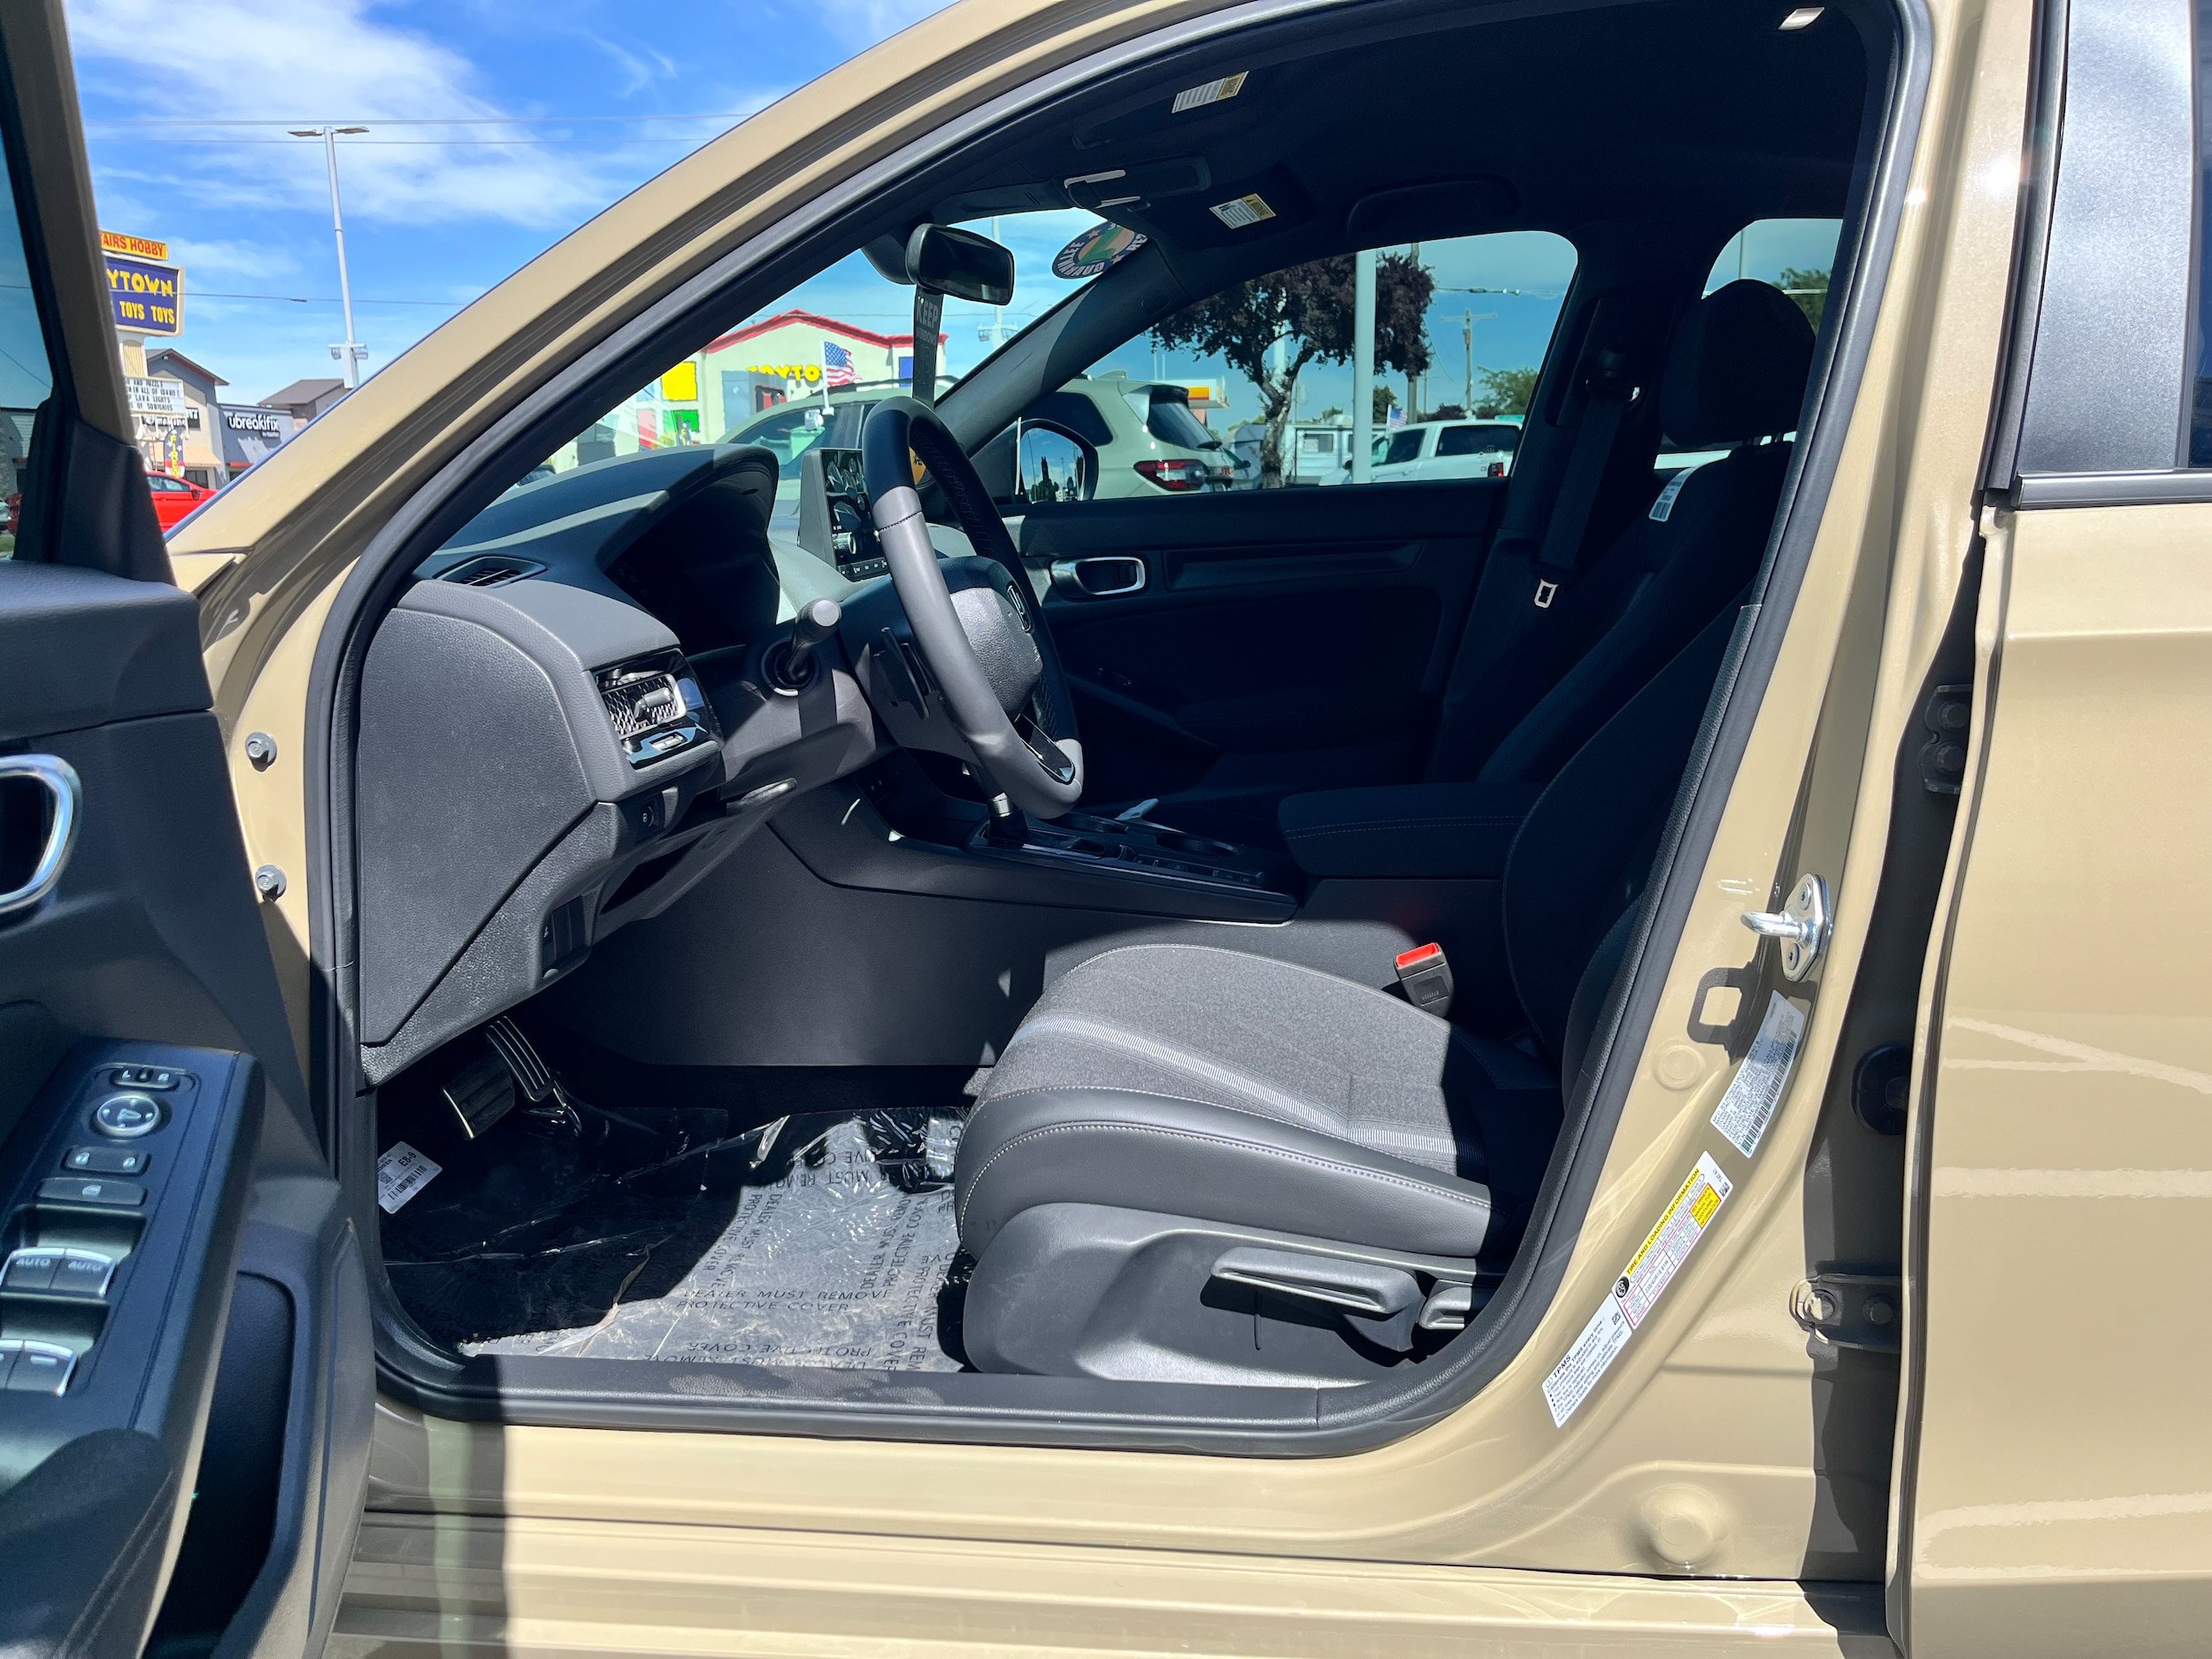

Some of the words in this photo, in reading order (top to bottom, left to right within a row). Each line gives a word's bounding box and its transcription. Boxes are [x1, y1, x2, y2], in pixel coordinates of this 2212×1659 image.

[101, 233, 127, 250] AIRS
[130, 239, 163, 257] HOBBY
[119, 300, 145, 320] TOYS
[150, 304, 175, 325] TOYS
[917, 296, 939, 329] KEEP
[228, 413, 279, 432] ubreakifix
[1626, 1257, 1637, 1275] TIRE
[1637, 1243, 1647, 1261] AND
[1647, 1213, 1669, 1245] LOADING
[1667, 1167, 1700, 1215] INFORMATION
[16, 1258, 51, 1267] AUTO
[68, 1261, 103, 1271] AUTO
[757, 1290, 806, 1300] MUST
[676, 1300, 782, 1310] PROTECTIVE
[787, 1302, 849, 1312] COVER
[687, 1341, 750, 1352] COVER
[1553, 1353, 1571, 1379] TPMS
